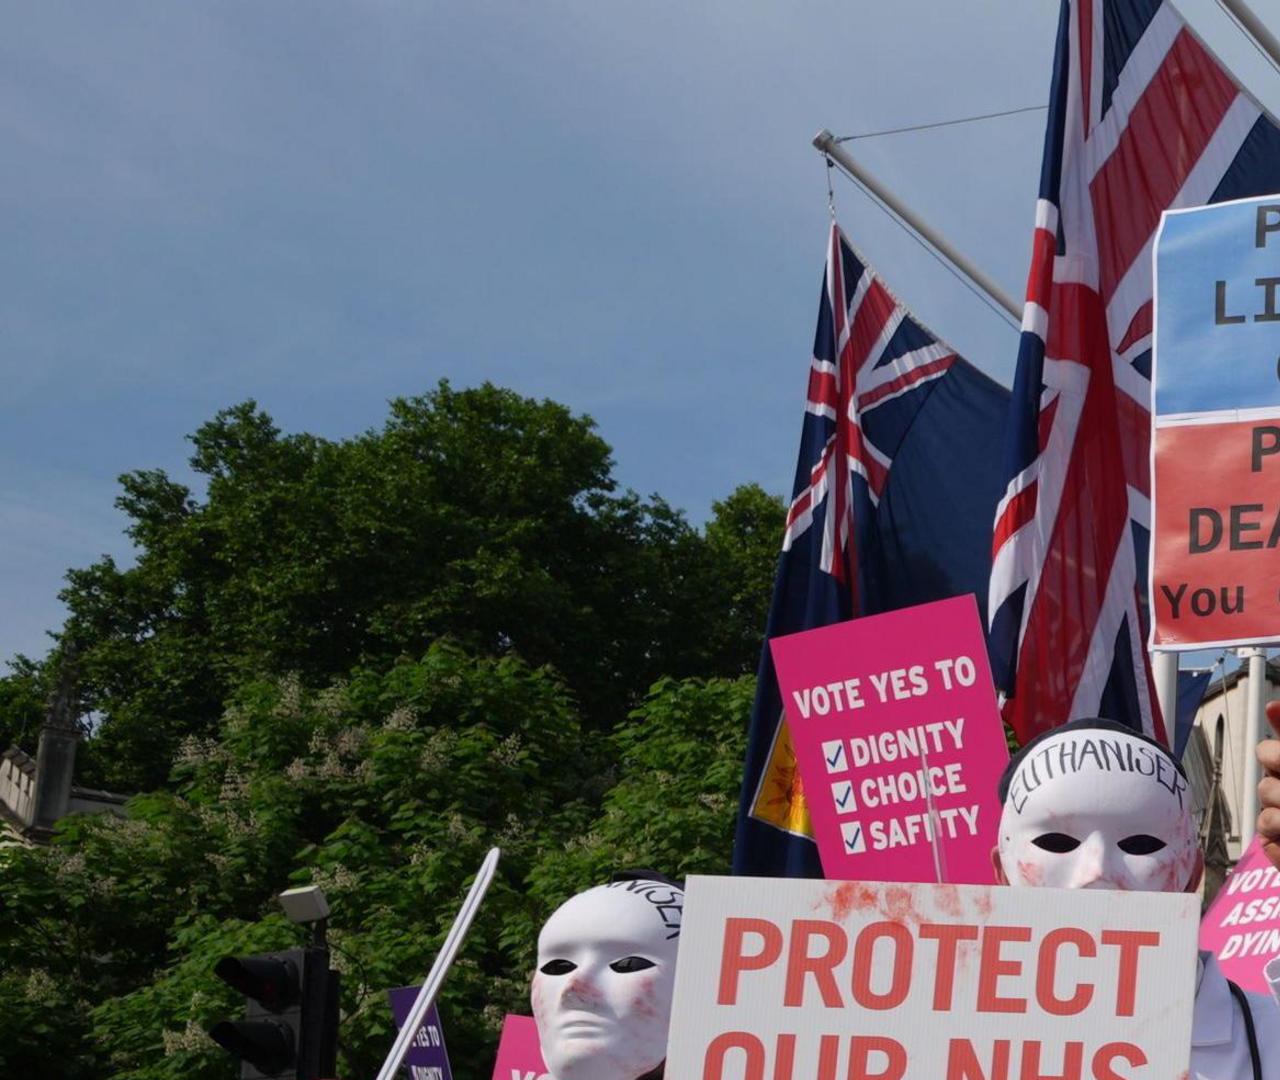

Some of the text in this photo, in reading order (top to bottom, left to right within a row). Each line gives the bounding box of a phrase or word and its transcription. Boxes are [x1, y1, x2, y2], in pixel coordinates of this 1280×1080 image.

[1161, 583, 1244, 619] You
[793, 656, 976, 719] VOTE YES TO
[850, 718, 965, 768] DIGNITY
[860, 763, 967, 808] CHOICE
[1010, 739, 1188, 815] EUTHANISER
[716, 917, 1160, 1017] PROTECT
